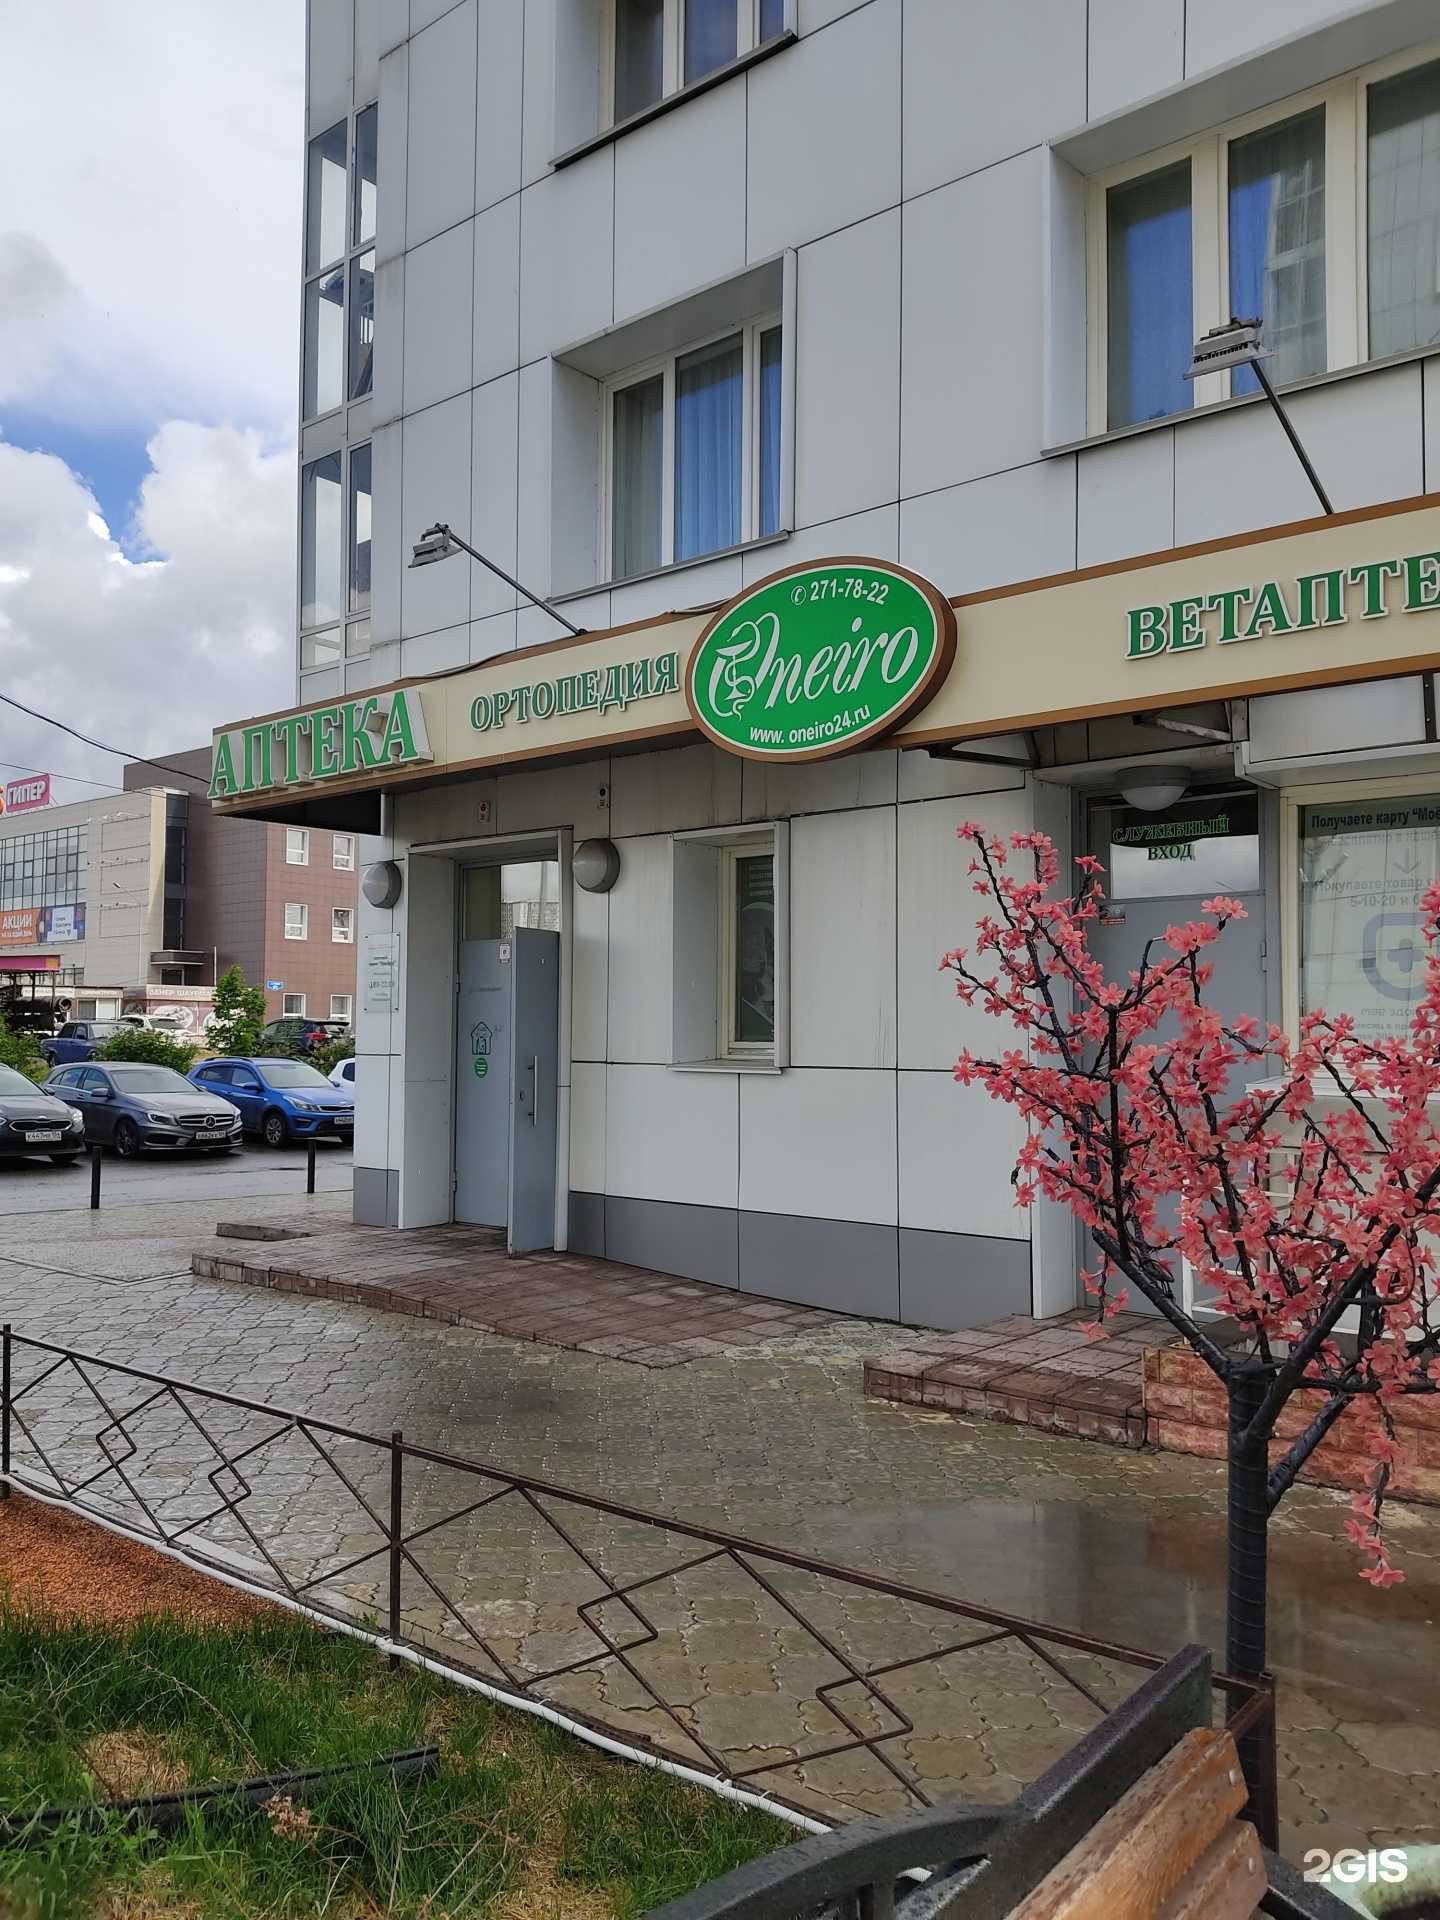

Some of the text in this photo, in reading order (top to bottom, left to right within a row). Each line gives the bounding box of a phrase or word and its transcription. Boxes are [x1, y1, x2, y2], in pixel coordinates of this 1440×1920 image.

[810, 578, 889, 605] 271-78-22
[1125, 551, 1440, 661] ВЕТАПТЕ
[708, 611, 919, 719] Oneiro
[470, 650, 680, 733] ОРТОПЕДИЯ
[750, 704, 871, 744] www. oneiro24.ru
[207, 688, 420, 800] АПТЕКА
[7, 780, 47, 805] ГИПЕР
[1112, 814, 1230, 842] СЛУЖЕБНЫЙ
[1376, 810, 1410, 826] карту
[1148, 843, 1194, 862] ВХОД
[2, 913, 33, 931] АКЦИИ
